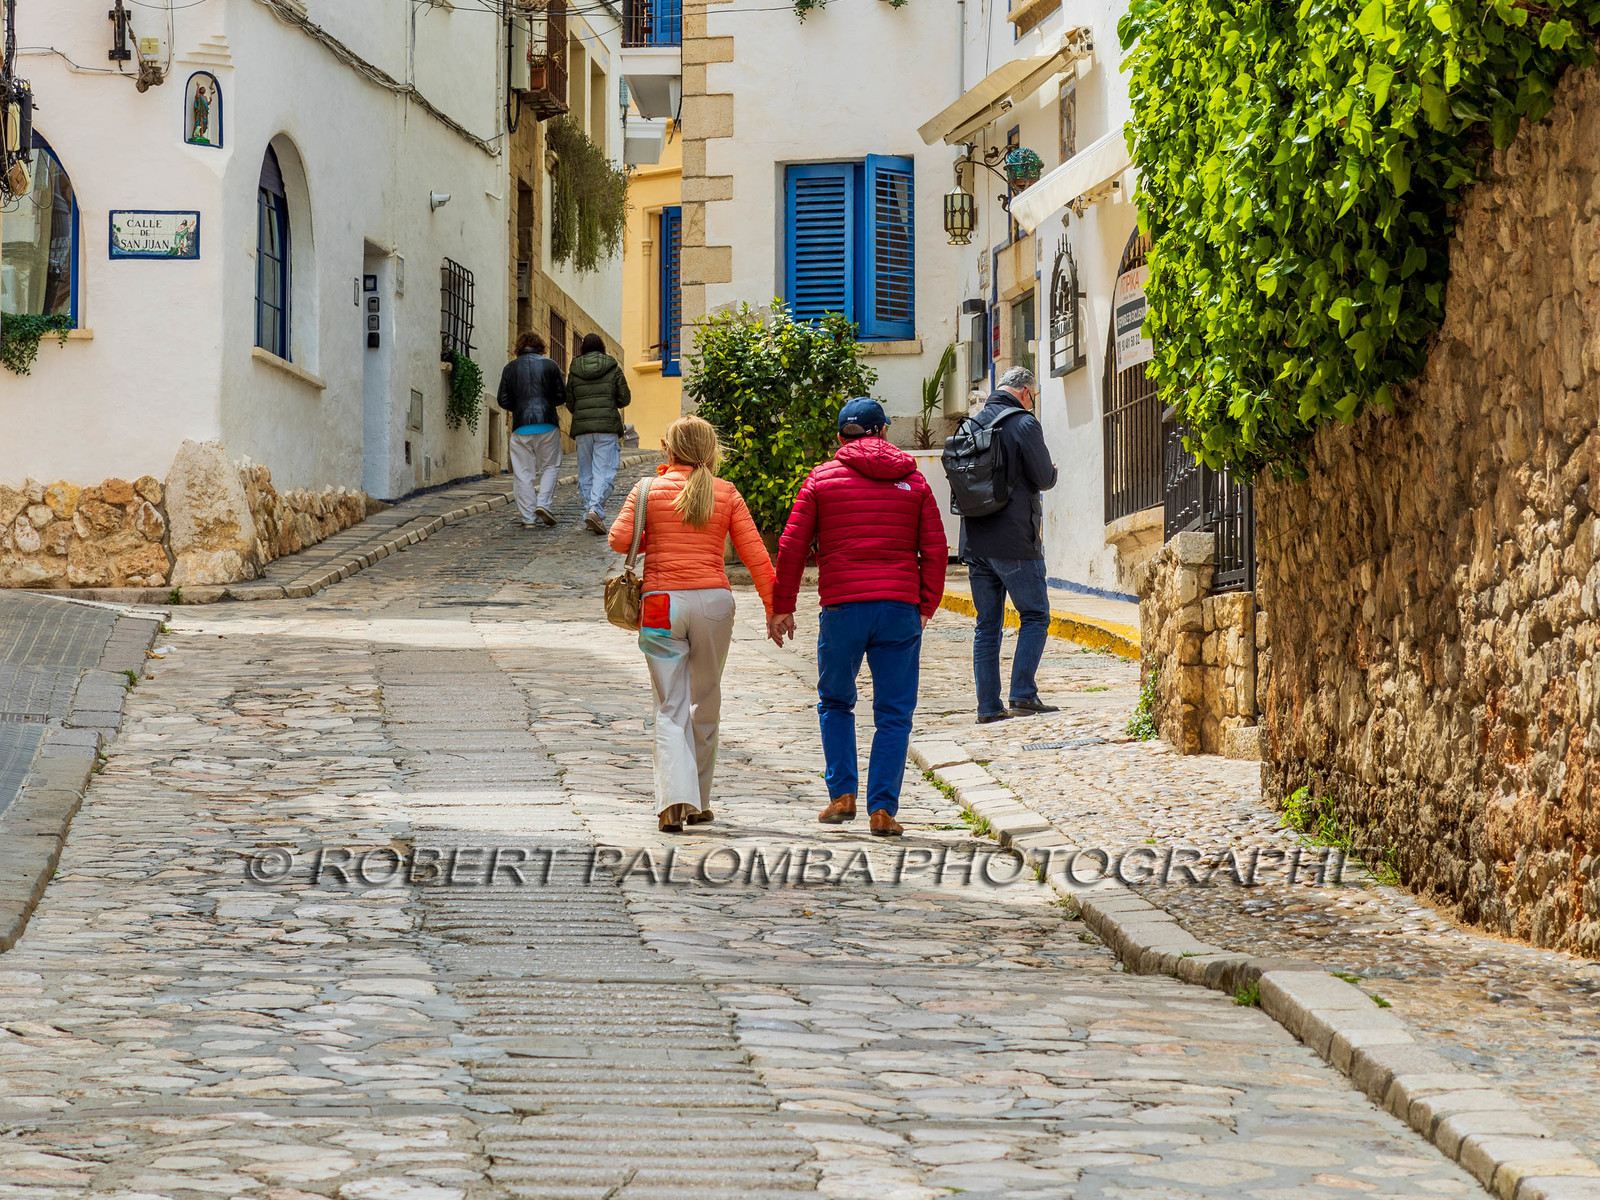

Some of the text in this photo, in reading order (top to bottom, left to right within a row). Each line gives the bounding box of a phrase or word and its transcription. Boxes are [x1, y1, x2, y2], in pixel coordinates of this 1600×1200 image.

[126, 219, 162, 228] CALLE
[140, 229, 151, 237] DE
[121, 239, 170, 250] SAN JUAN
